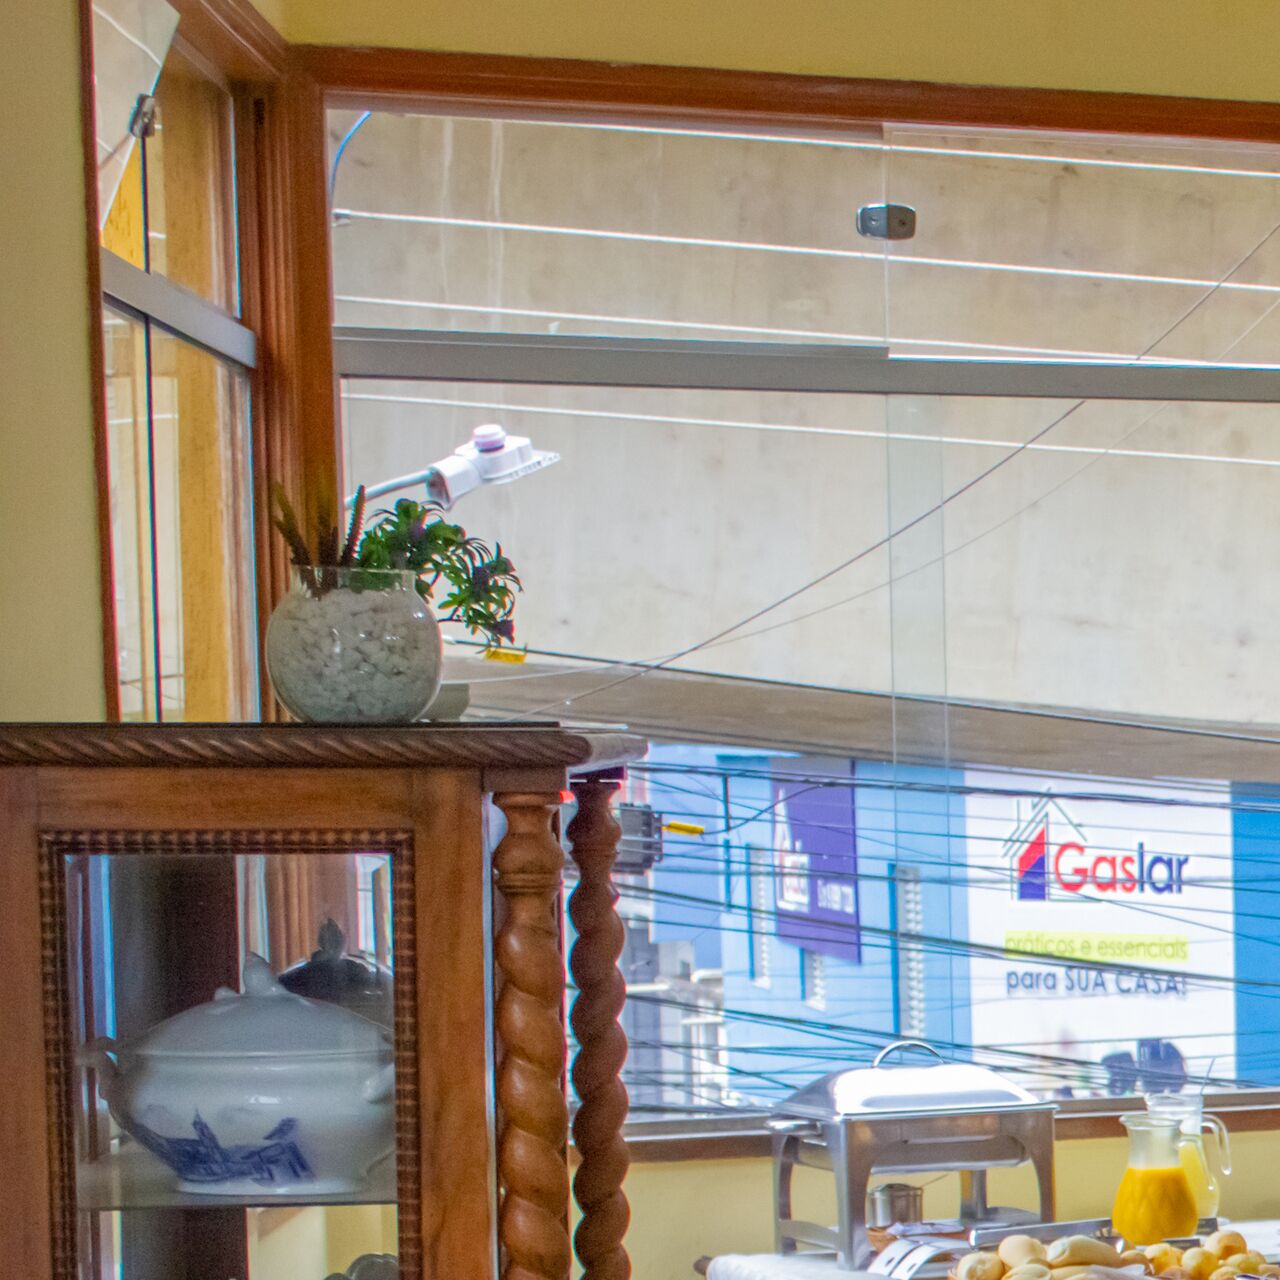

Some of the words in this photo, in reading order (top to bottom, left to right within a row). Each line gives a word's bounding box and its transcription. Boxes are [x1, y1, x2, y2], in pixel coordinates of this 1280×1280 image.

[1054, 841, 1190, 894] Gaslar
[1006, 931, 1075, 956] práticos
[1080, 939, 1092, 955] e
[1097, 936, 1189, 961] essenciais
[1006, 970, 1057, 995] para
[1064, 966, 1106, 992] SUA
[1115, 970, 1188, 996] CASA!
